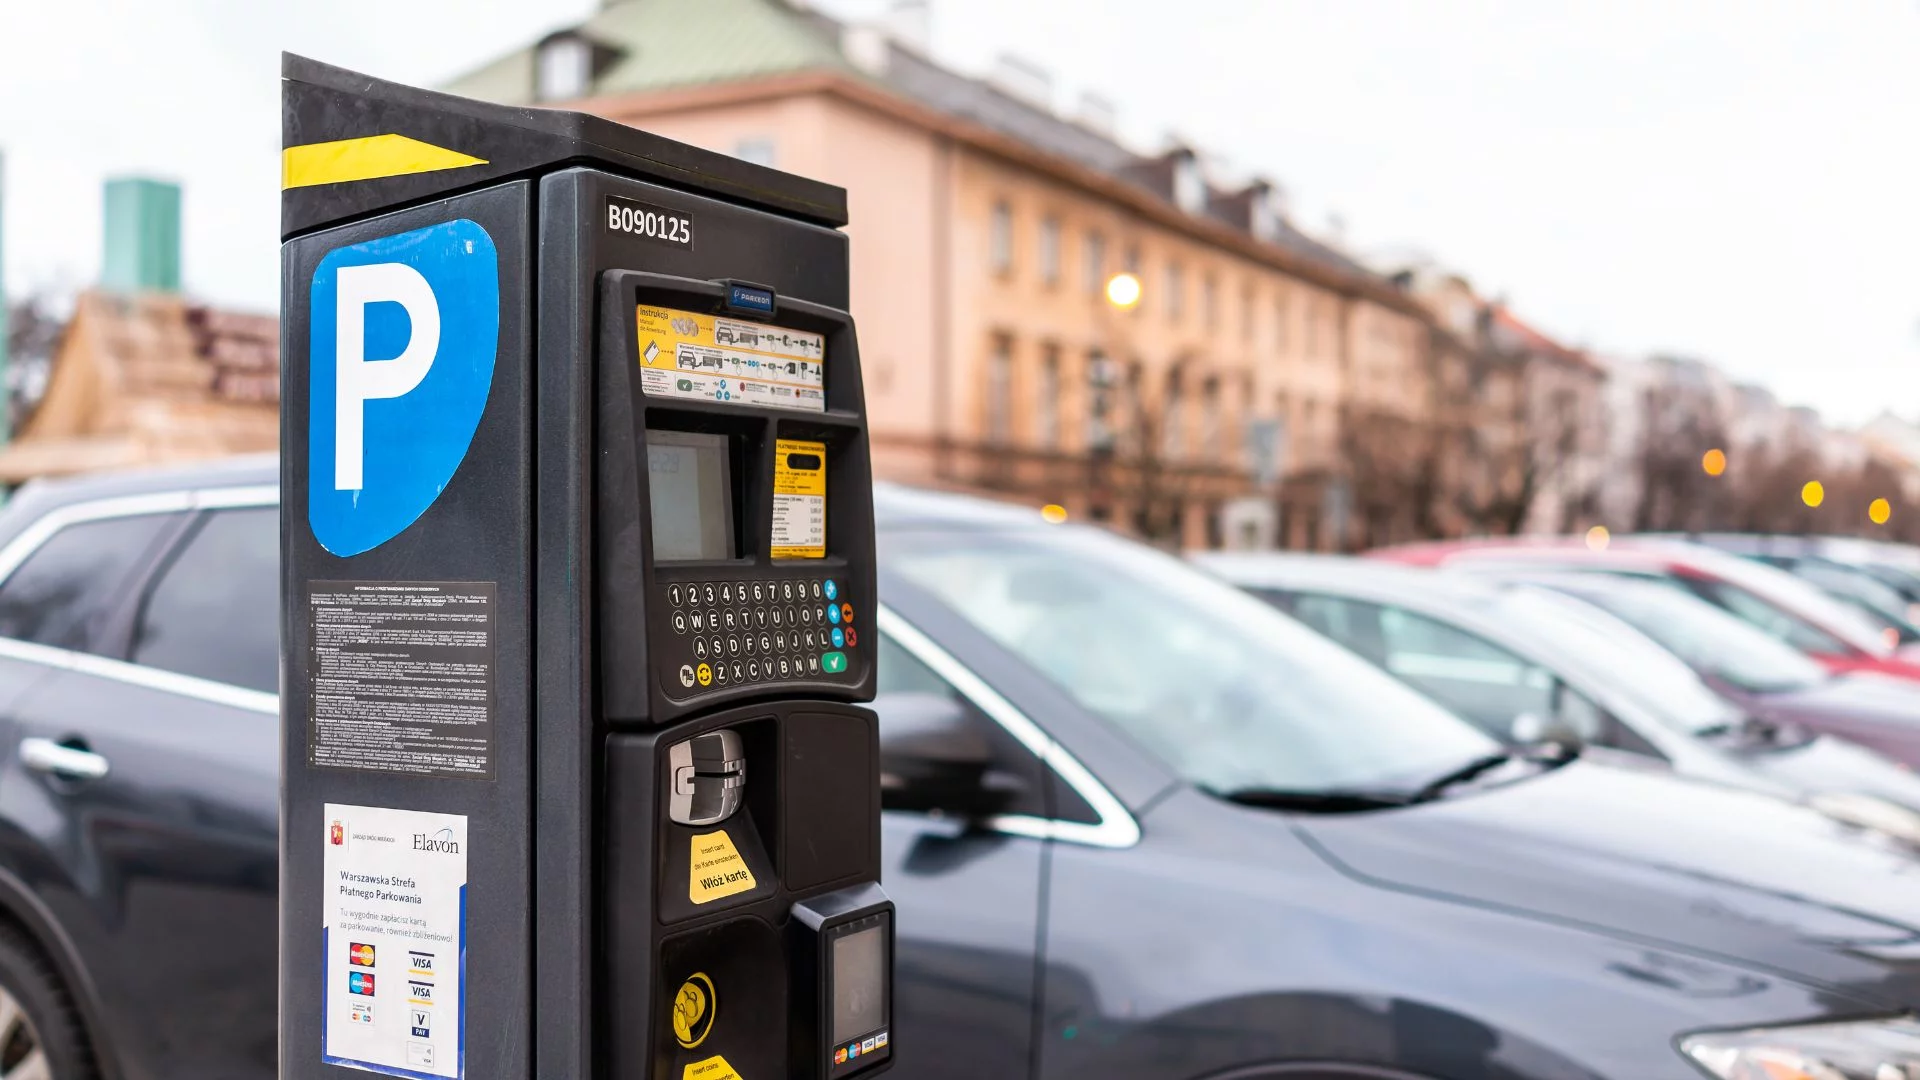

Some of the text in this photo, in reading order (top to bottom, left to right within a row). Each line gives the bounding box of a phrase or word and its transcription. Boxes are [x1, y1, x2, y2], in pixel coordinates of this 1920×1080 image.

[609, 205, 690, 243] B090125
[640, 307, 669, 320] Instrukcja
[335, 262, 440, 490] P
[689, 588, 698, 602] 2
[706, 587, 714, 602] 3
[723, 586, 730, 601] 4
[738, 586, 746, 600] 5
[754, 586, 762, 600] 6
[769, 585, 776, 599] 7
[784, 584, 792, 598] 8
[798, 584, 806, 598] 9
[675, 616, 685, 629] Q
[691, 615, 702, 628] W
[710, 614, 718, 627] E
[726, 614, 735, 626] R
[742, 613, 749, 625] T
[757, 612, 764, 624] Y
[772, 611, 780, 623] U
[816, 609, 823, 621] P
[697, 633, 828, 654] A S D F G H J K L
[717, 658, 818, 679] Z X C V B N M
[413, 834, 460, 854] Elavon
[340, 870, 415, 888] Warszawska Strefa
[700, 870, 748, 890] Włóż kartę
[340, 886, 422, 904] Płatnego Parkowania
[350, 910, 378, 920] wygodnie
[380, 913, 408, 924] zapłacisz
[410, 916, 426, 927] kartą
[348, 922, 385, 934] parkowanie,
[387, 928, 411, 937] również
[413, 930, 453, 942] zbliżeniowo!
[412, 957, 432, 969] VISA
[412, 986, 431, 998] VISA
[416, 1014, 425, 1025] V
